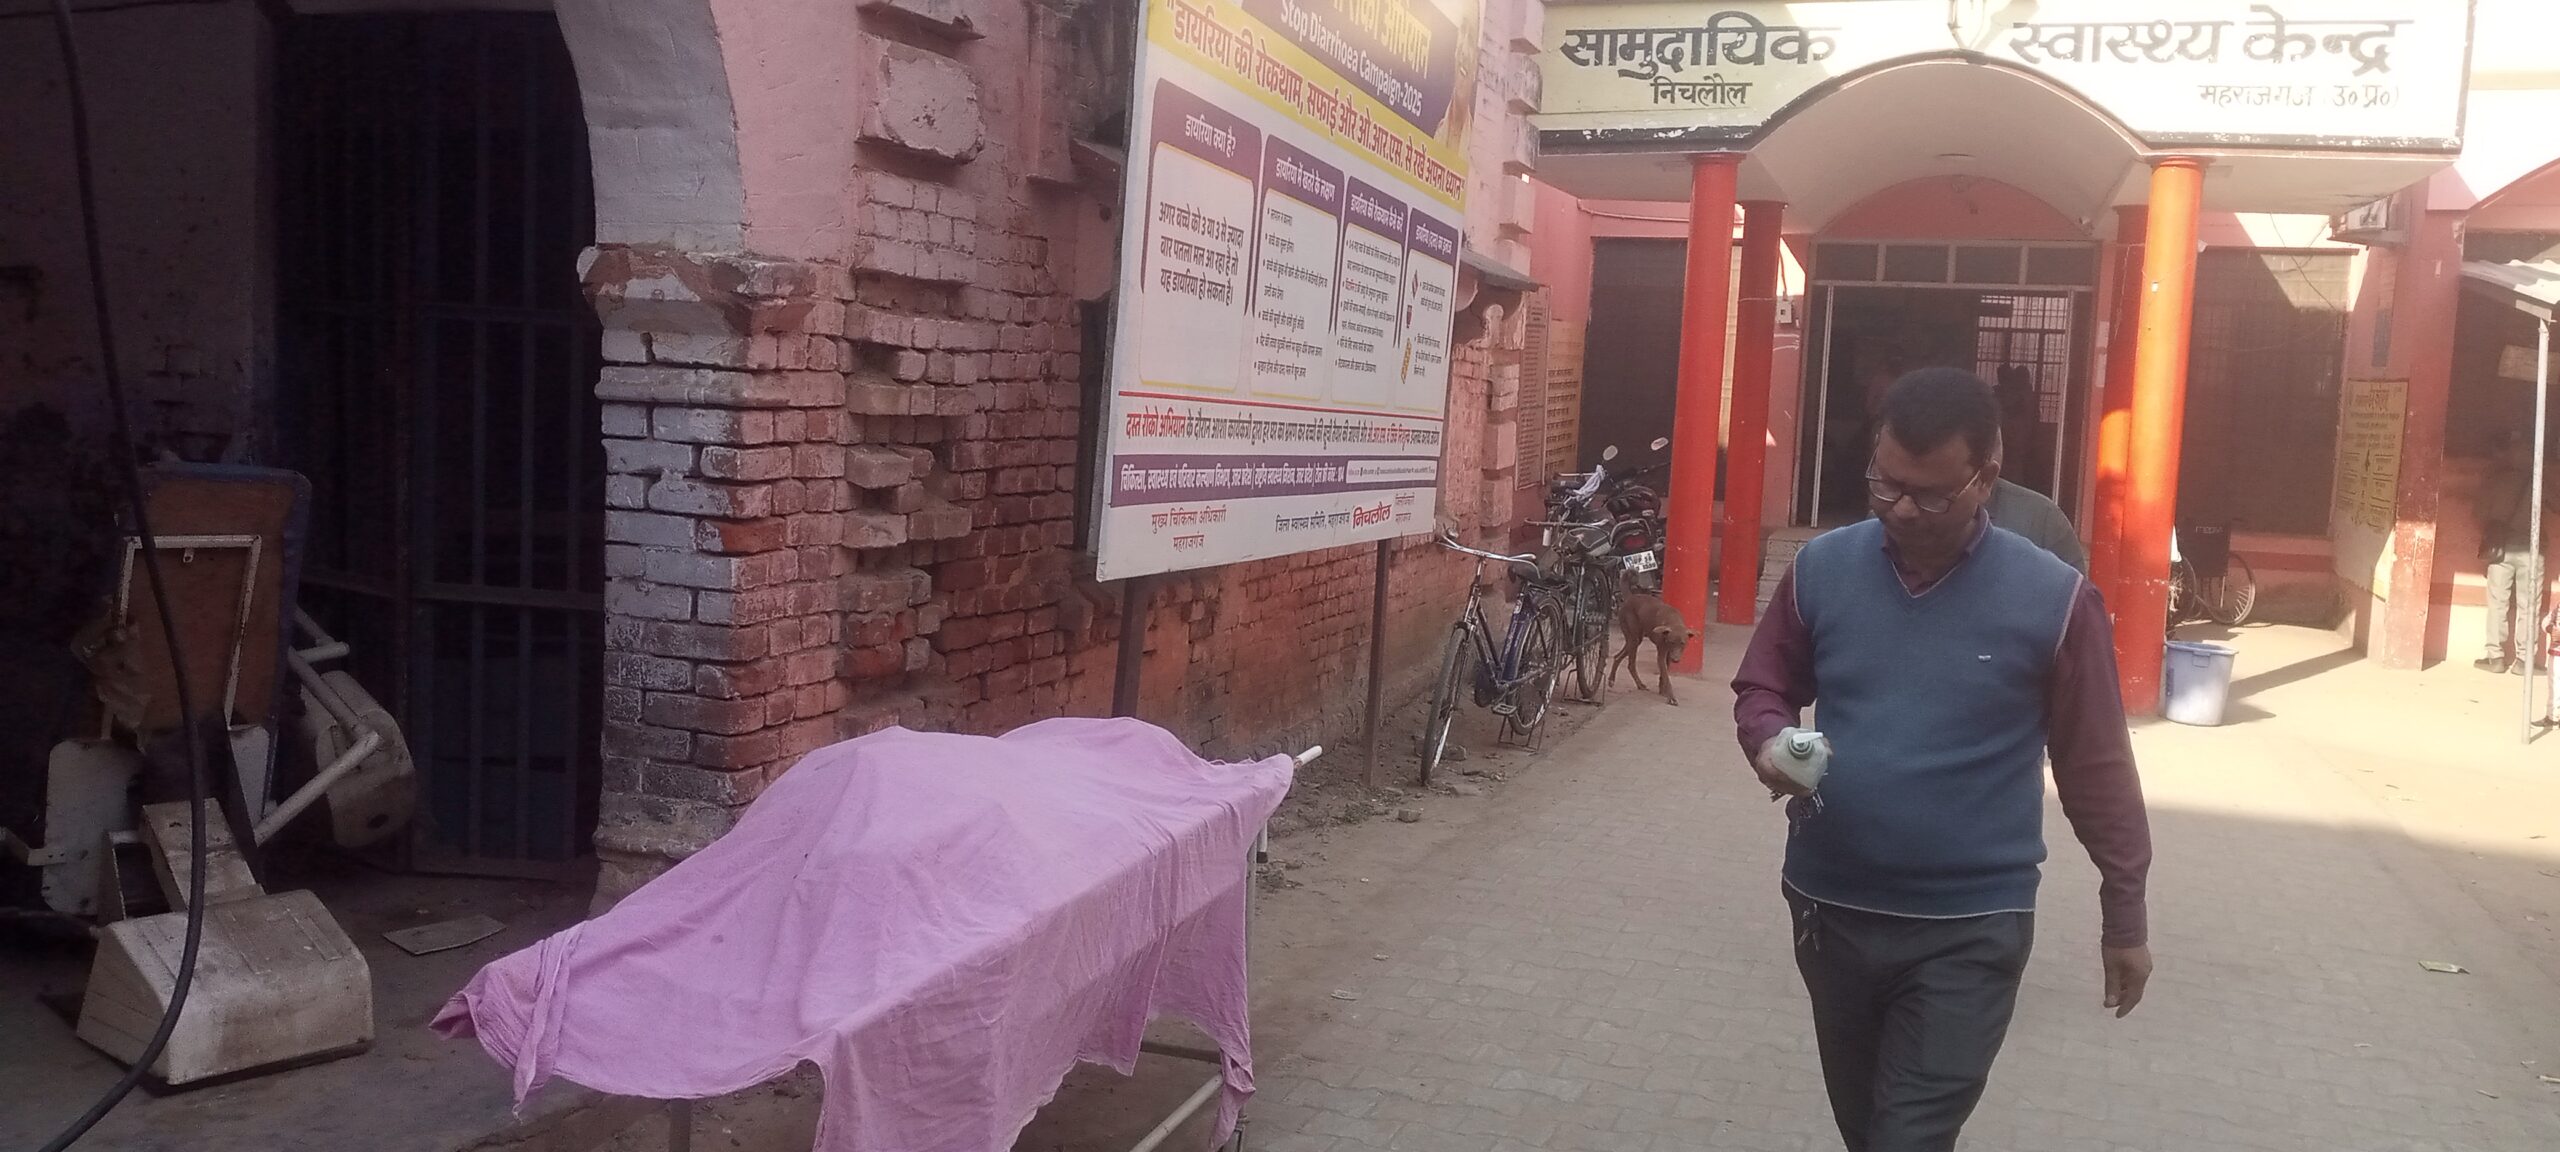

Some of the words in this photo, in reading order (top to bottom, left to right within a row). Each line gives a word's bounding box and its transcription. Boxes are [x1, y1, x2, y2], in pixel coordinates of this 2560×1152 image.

[1281, 0, 1308, 42] Stop
[1309, 11, 1358, 73] Diarrhoea
[1360, 50, 1422, 117] Campaign-2025
[1559, 10, 1842, 80] सामुदायिक
[2008, 18, 2235, 64] स्वास्थ्य
[2244, 4, 2415, 77] केन्द्र
[1234, 28, 1254, 79] की
[1256, 38, 1303, 114] रोकथाम,
[1307, 82, 1339, 136] सफाई
[1338, 94, 1356, 141] और
[1405, 135, 1414, 173] से
[1413, 143, 1426, 179] रखें
[1426, 157, 1445, 191] अपना
[1650, 73, 1753, 106] निचलौल
[1185, 114, 1212, 145] डायरिया
[1213, 127, 1226, 153] क्या
[1226, 125, 1236, 157] है?
[1276, 156, 1298, 184] डायरिया
[1302, 168, 1315, 193] खतरे
[1314, 170, 1320, 195] के
[1320, 178, 1335, 202] लक्षण
[1159, 202, 1175, 226] अगर
[1176, 203, 1190, 230] बच्चे
[1191, 207, 1201, 235] को
[1201, 216, 1207, 236] 3
[1207, 218, 1215, 239] या
[1215, 219, 1221, 240] 3
[1220, 217, 1228, 242] से
[1160, 235, 1173, 258] बार
[1173, 238, 1193, 263] पतला
[1193, 243, 1204, 267] मल
[1205, 248, 1214, 269] आ
[1214, 251, 1225, 275] रहा
[1225, 245, 1231, 276] है
[1231, 250, 1238, 275] तो
[1160, 268, 1172, 294] यह
[1172, 268, 1198, 297] डायरिया
[1198, 272, 1206, 301] हो
[1206, 279, 1225, 303] सकता
[1126, 413, 1141, 438] दस्त
[1142, 405, 1159, 437] रोको
[1159, 407, 1186, 437] अभियान
[1187, 408, 1194, 438] के
[1194, 407, 1211, 440] दौरान
[1211, 418, 1227, 439] आशा
[1252, 420, 1262, 445] द्वारा
[1262, 421, 1270, 444] हर
[1270, 421, 1277, 442] घर
[1277, 421, 1285, 442] का
[1298, 423, 1305, 442] कर
[1121, 464, 1146, 492] चिकित्सा,
[1147, 468, 1169, 490] स्वास्थ्य
[1169, 464, 1177, 488] एवं
[1177, 463, 1195, 488] परिवार
[1195, 468, 1215, 488] कल्याण
[1267, 468, 1282, 486] स्वास्थ्य
[1151, 513, 1168, 534] मुख्य
[1169, 508, 1198, 526] चिकित्सा
[1199, 504, 1227, 524] अधिकारी
[1276, 514, 1291, 532] जिला
[1291, 517, 1309, 531] स्वास्थ्य
[1353, 501, 1392, 529] निचलौल
[1173, 531, 1204, 552] महराजगंज
